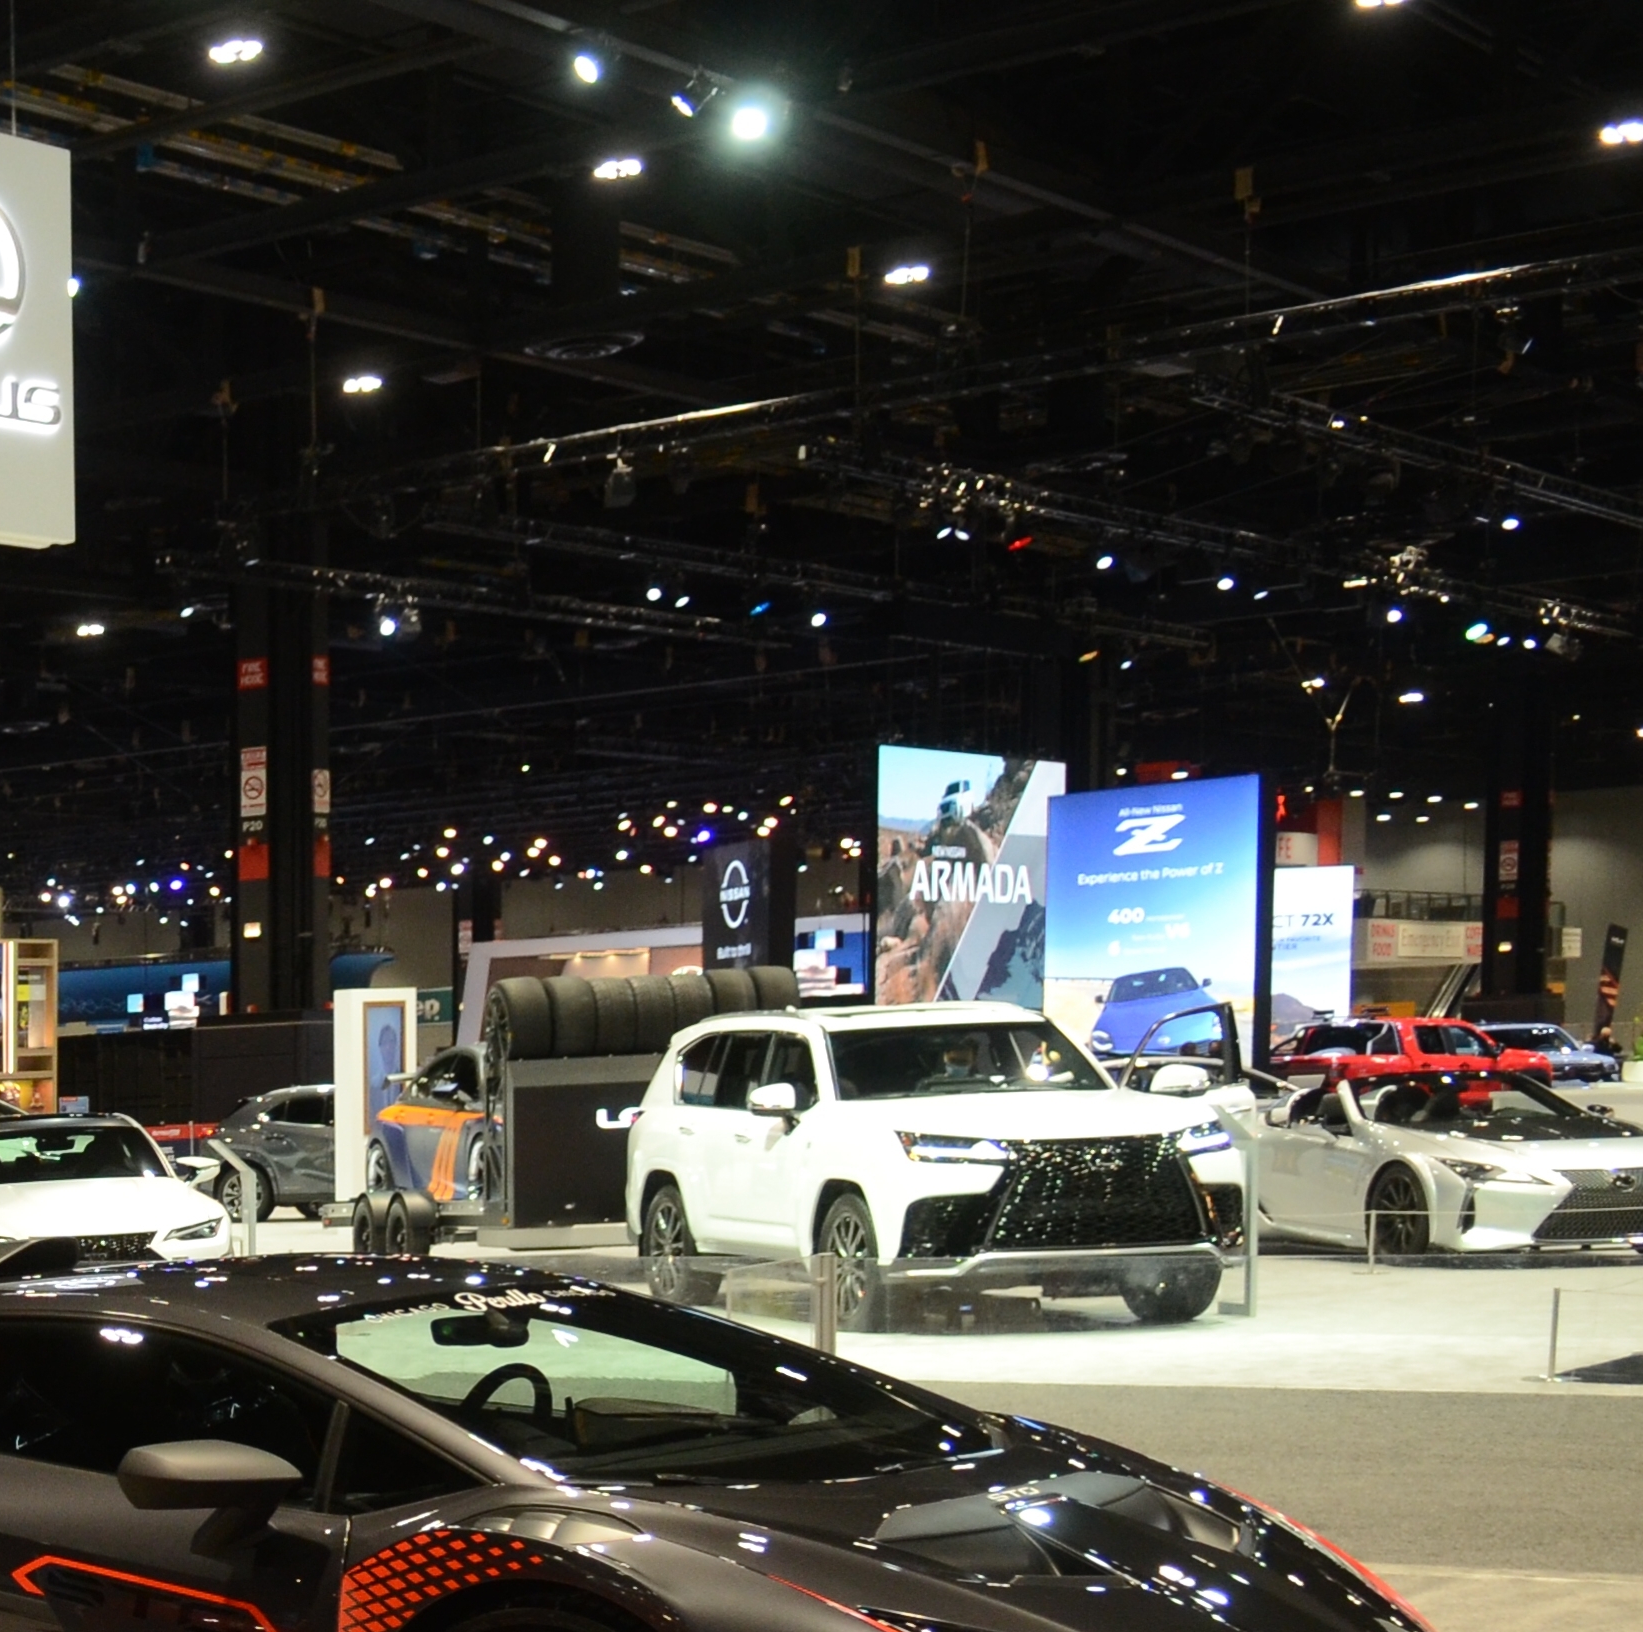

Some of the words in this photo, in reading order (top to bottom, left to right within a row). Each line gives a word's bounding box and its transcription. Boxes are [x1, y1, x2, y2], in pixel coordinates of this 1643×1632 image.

[1153, 803, 1183, 814] Nissan
[242, 820, 263, 832] P20
[909, 860, 1033, 904] ARMADA
[1077, 870, 1138, 886] Experience
[1140, 868, 1159, 881] the
[1162, 866, 1198, 879] Power
[1200, 863, 1213, 875] of
[1215, 862, 1224, 874] Z
[1108, 907, 1145, 924] 400
[1301, 913, 1334, 927] 72X
[454, 1289, 547, 1312] Perillo
